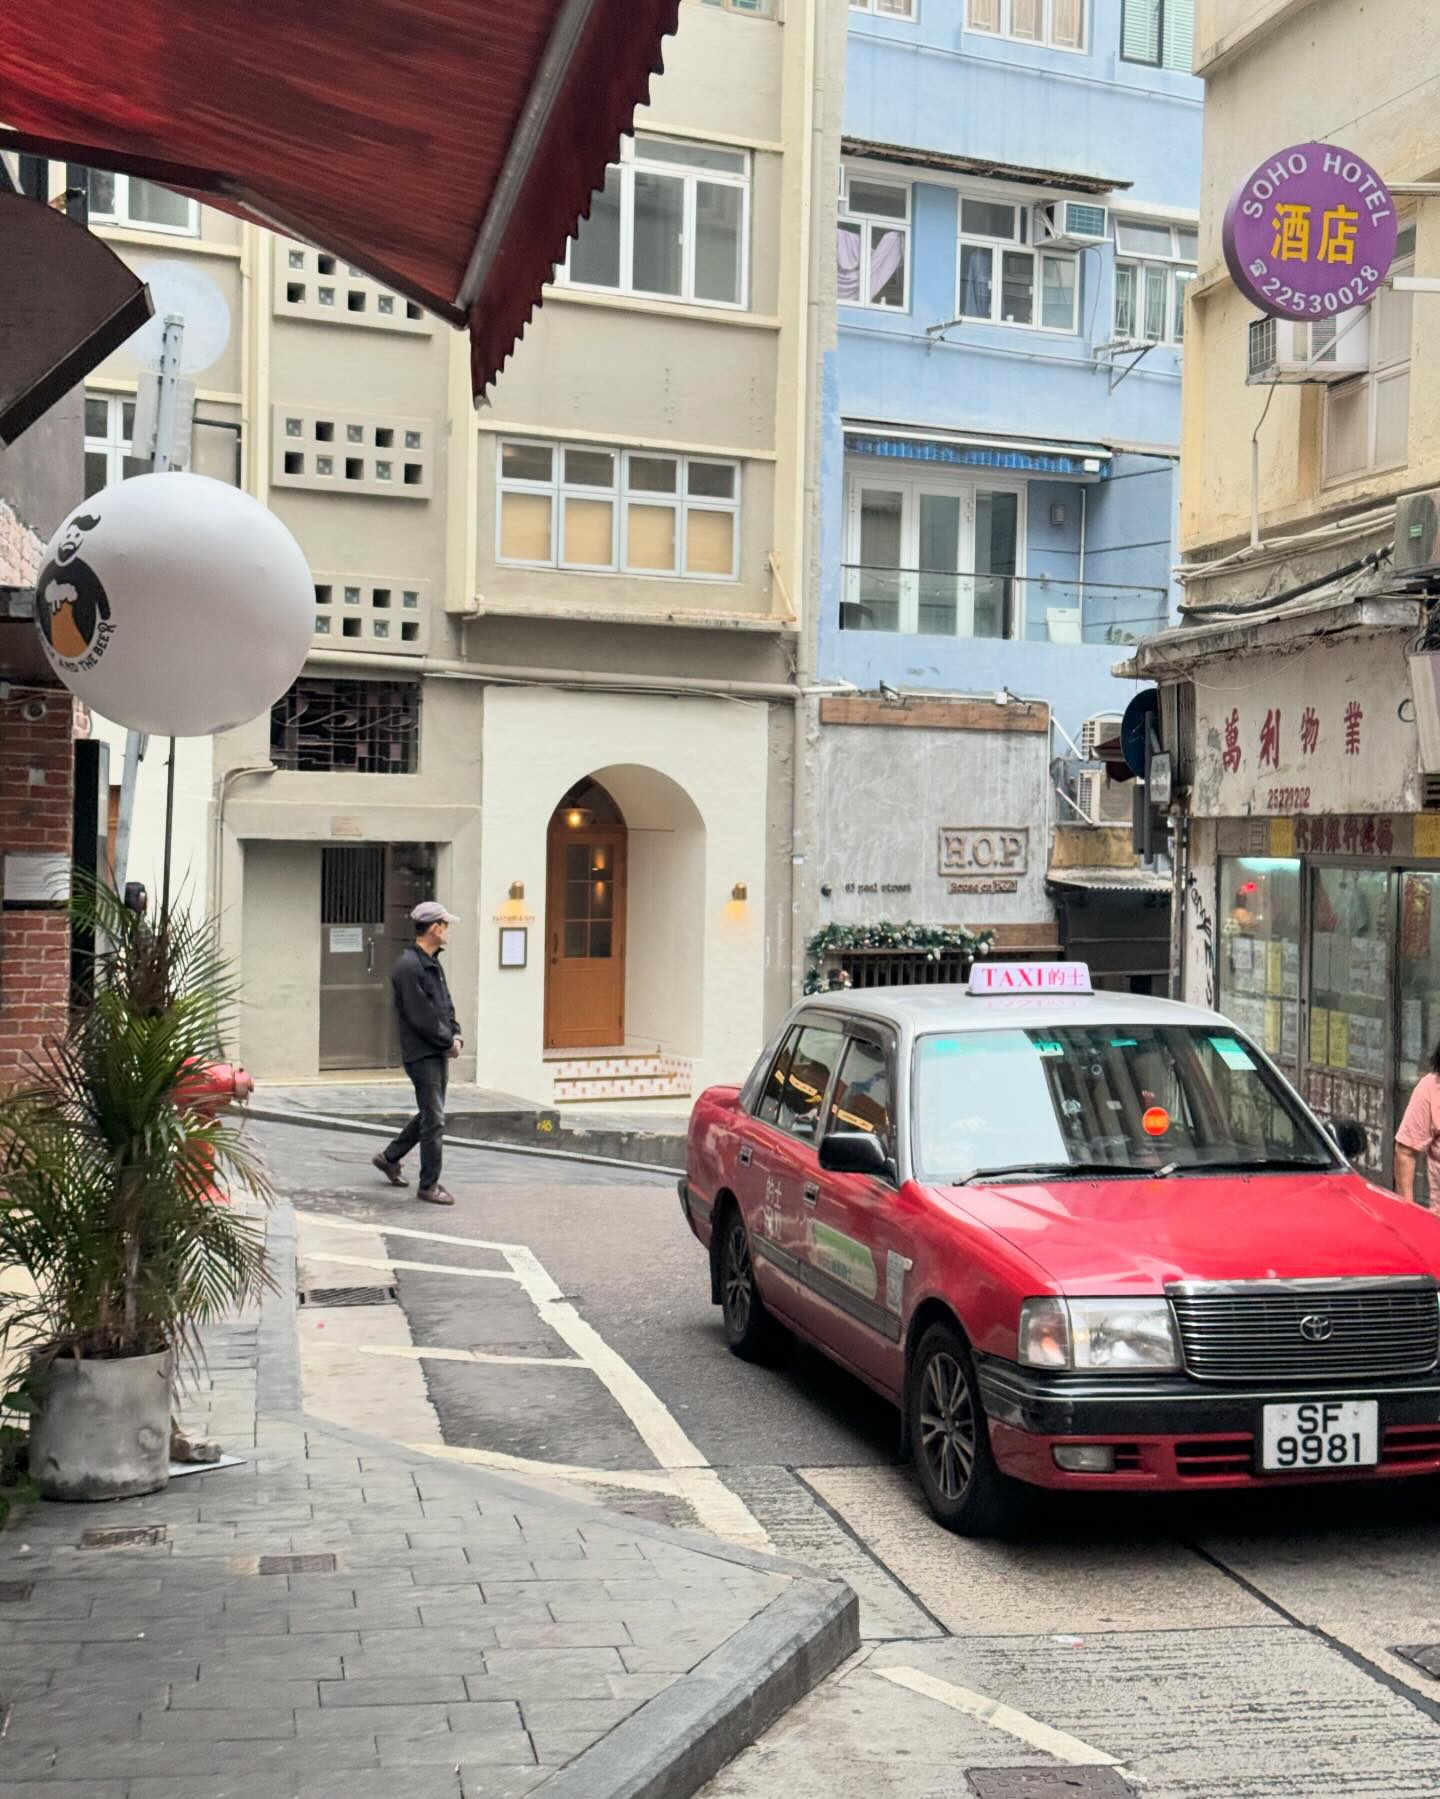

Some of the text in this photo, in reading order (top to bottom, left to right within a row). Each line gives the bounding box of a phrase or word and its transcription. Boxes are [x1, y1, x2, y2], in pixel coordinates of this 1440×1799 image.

[1243, 152, 1390, 227] SOHO HOTEL
[1270, 202, 1359, 264] 酒店
[1262, 264, 1378, 313] 22530028
[93, 622, 117, 656] BEER
[1222, 700, 1363, 773] 萬利物業
[982, 968, 1084, 987] TAXI 的士
[1297, 1403, 1343, 1434] SF
[1277, 1433, 1360, 1466] 9981
